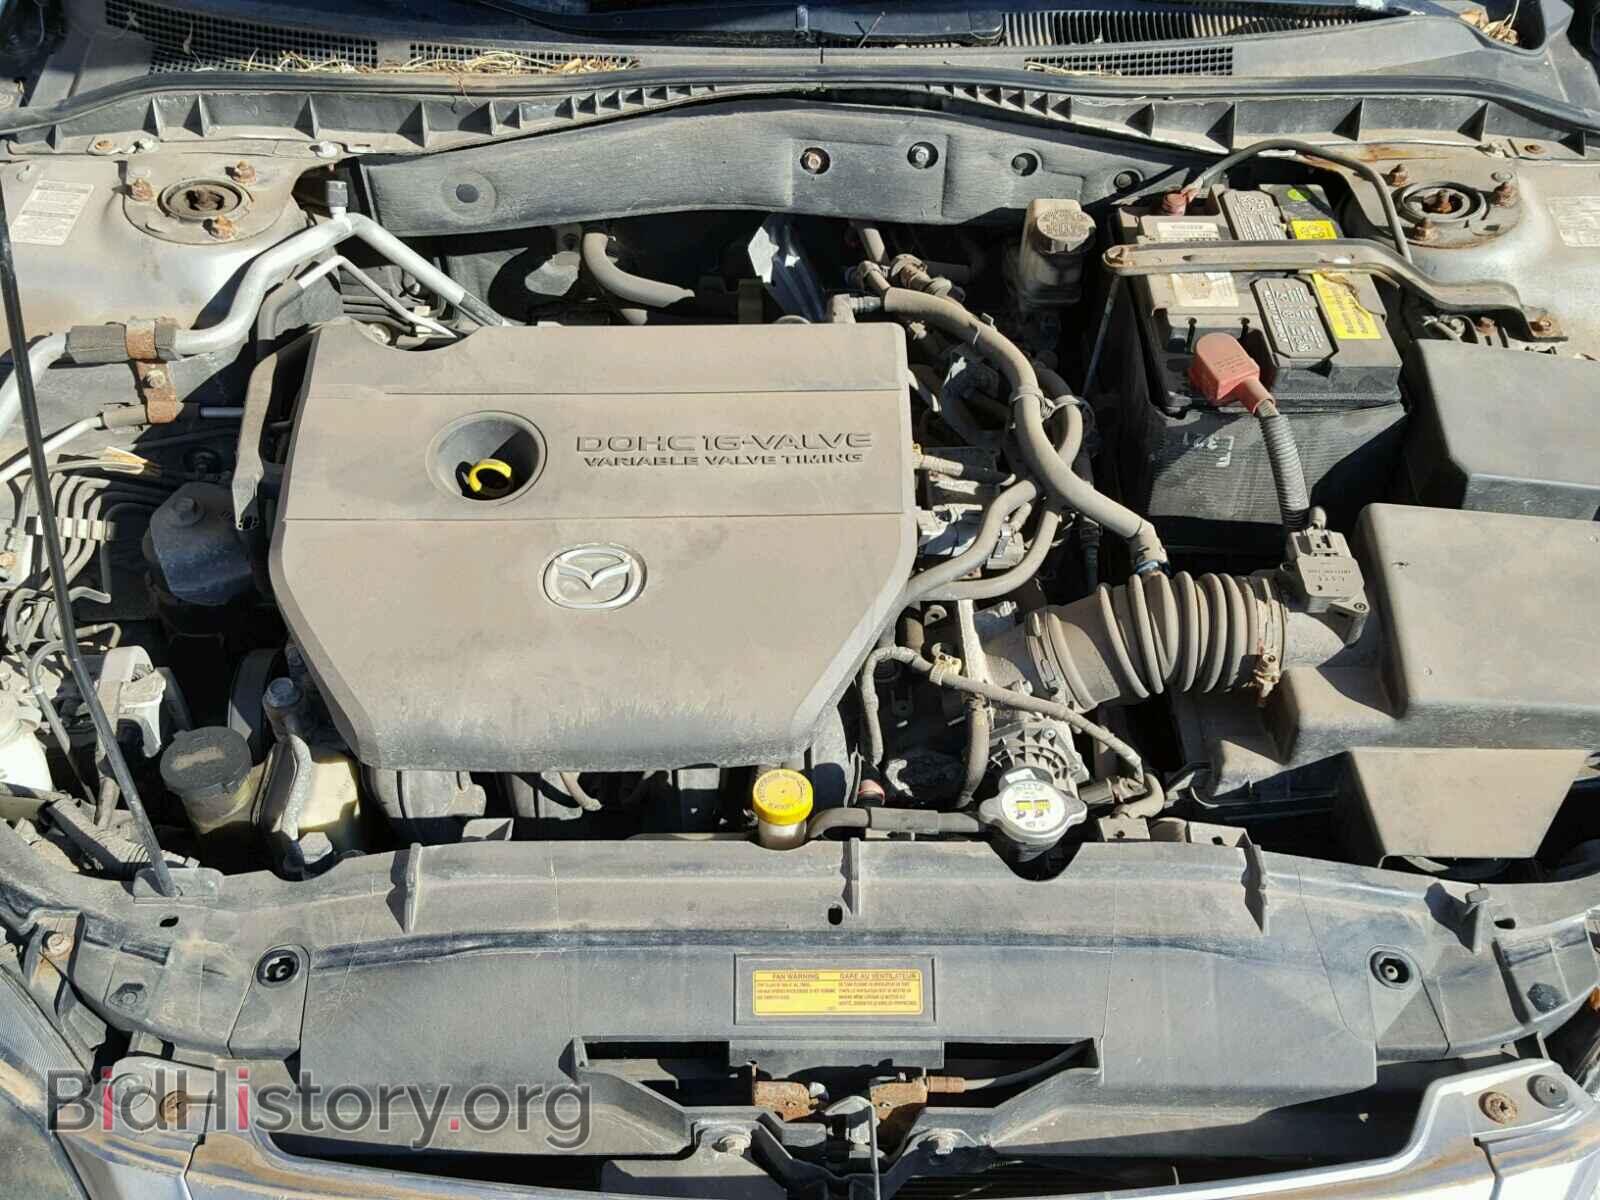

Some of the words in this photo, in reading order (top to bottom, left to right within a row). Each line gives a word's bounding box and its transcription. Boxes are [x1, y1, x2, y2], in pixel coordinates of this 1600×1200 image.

[576, 435, 697, 452] DOHC
[701, 432, 872, 451] 16-VALVE
[583, 455, 699, 467] VARIABLE
[704, 455, 777, 465] VALVE
[782, 452, 864, 464] TIMING
